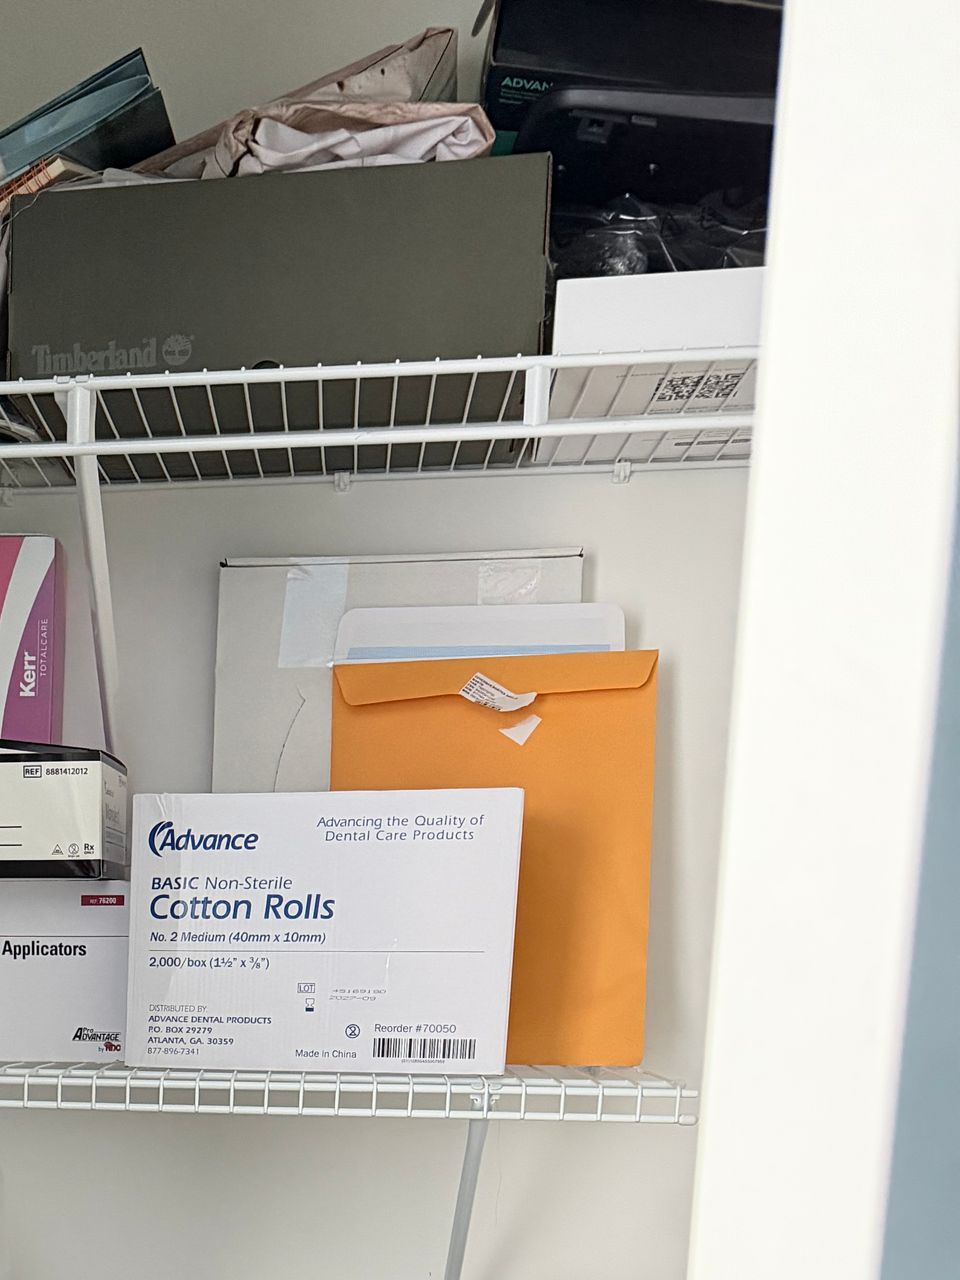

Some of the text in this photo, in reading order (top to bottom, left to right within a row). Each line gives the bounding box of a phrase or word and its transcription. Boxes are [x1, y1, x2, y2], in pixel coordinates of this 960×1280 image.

[32, 338, 157, 375] Timberland
[40, 618, 49, 677] TOTALCARE
[19, 652, 37, 697] Kerr
[25, 767, 89, 776] REF 8881412012
[317, 814, 486, 830] Advancing the Quality of
[157, 827, 260, 851] Advance
[325, 829, 475, 842] Dental Care Products
[83, 843, 95, 851] Rx
[151, 876, 293, 890] BASIC Non-Sterile
[150, 893, 336, 920] Cotton Rolls
[150, 931, 327, 944] No. 2 Medium (40mm x 10mm)
[2, 940, 87, 960] Applicators
[149, 957, 207, 969] 2,000/box
[240, 959, 247, 967] x
[298, 984, 315, 993] LOT
[149, 1004, 196, 1012] DISTRIBUTED
[148, 1015, 272, 1025] ADVANCE DENTAL PRODUCTS
[72, 1027, 121, 1042] ADVANTAGE
[166, 1026, 183, 1034] BOX
[186, 1026, 213, 1034] 29279
[374, 1023, 457, 1034] Reorder #70050
[147, 1036, 234, 1046] ATLANTA, GA. 30359
[147, 1047, 200, 1055] 877-896-7341
[295, 1049, 357, 1059] Made in China
